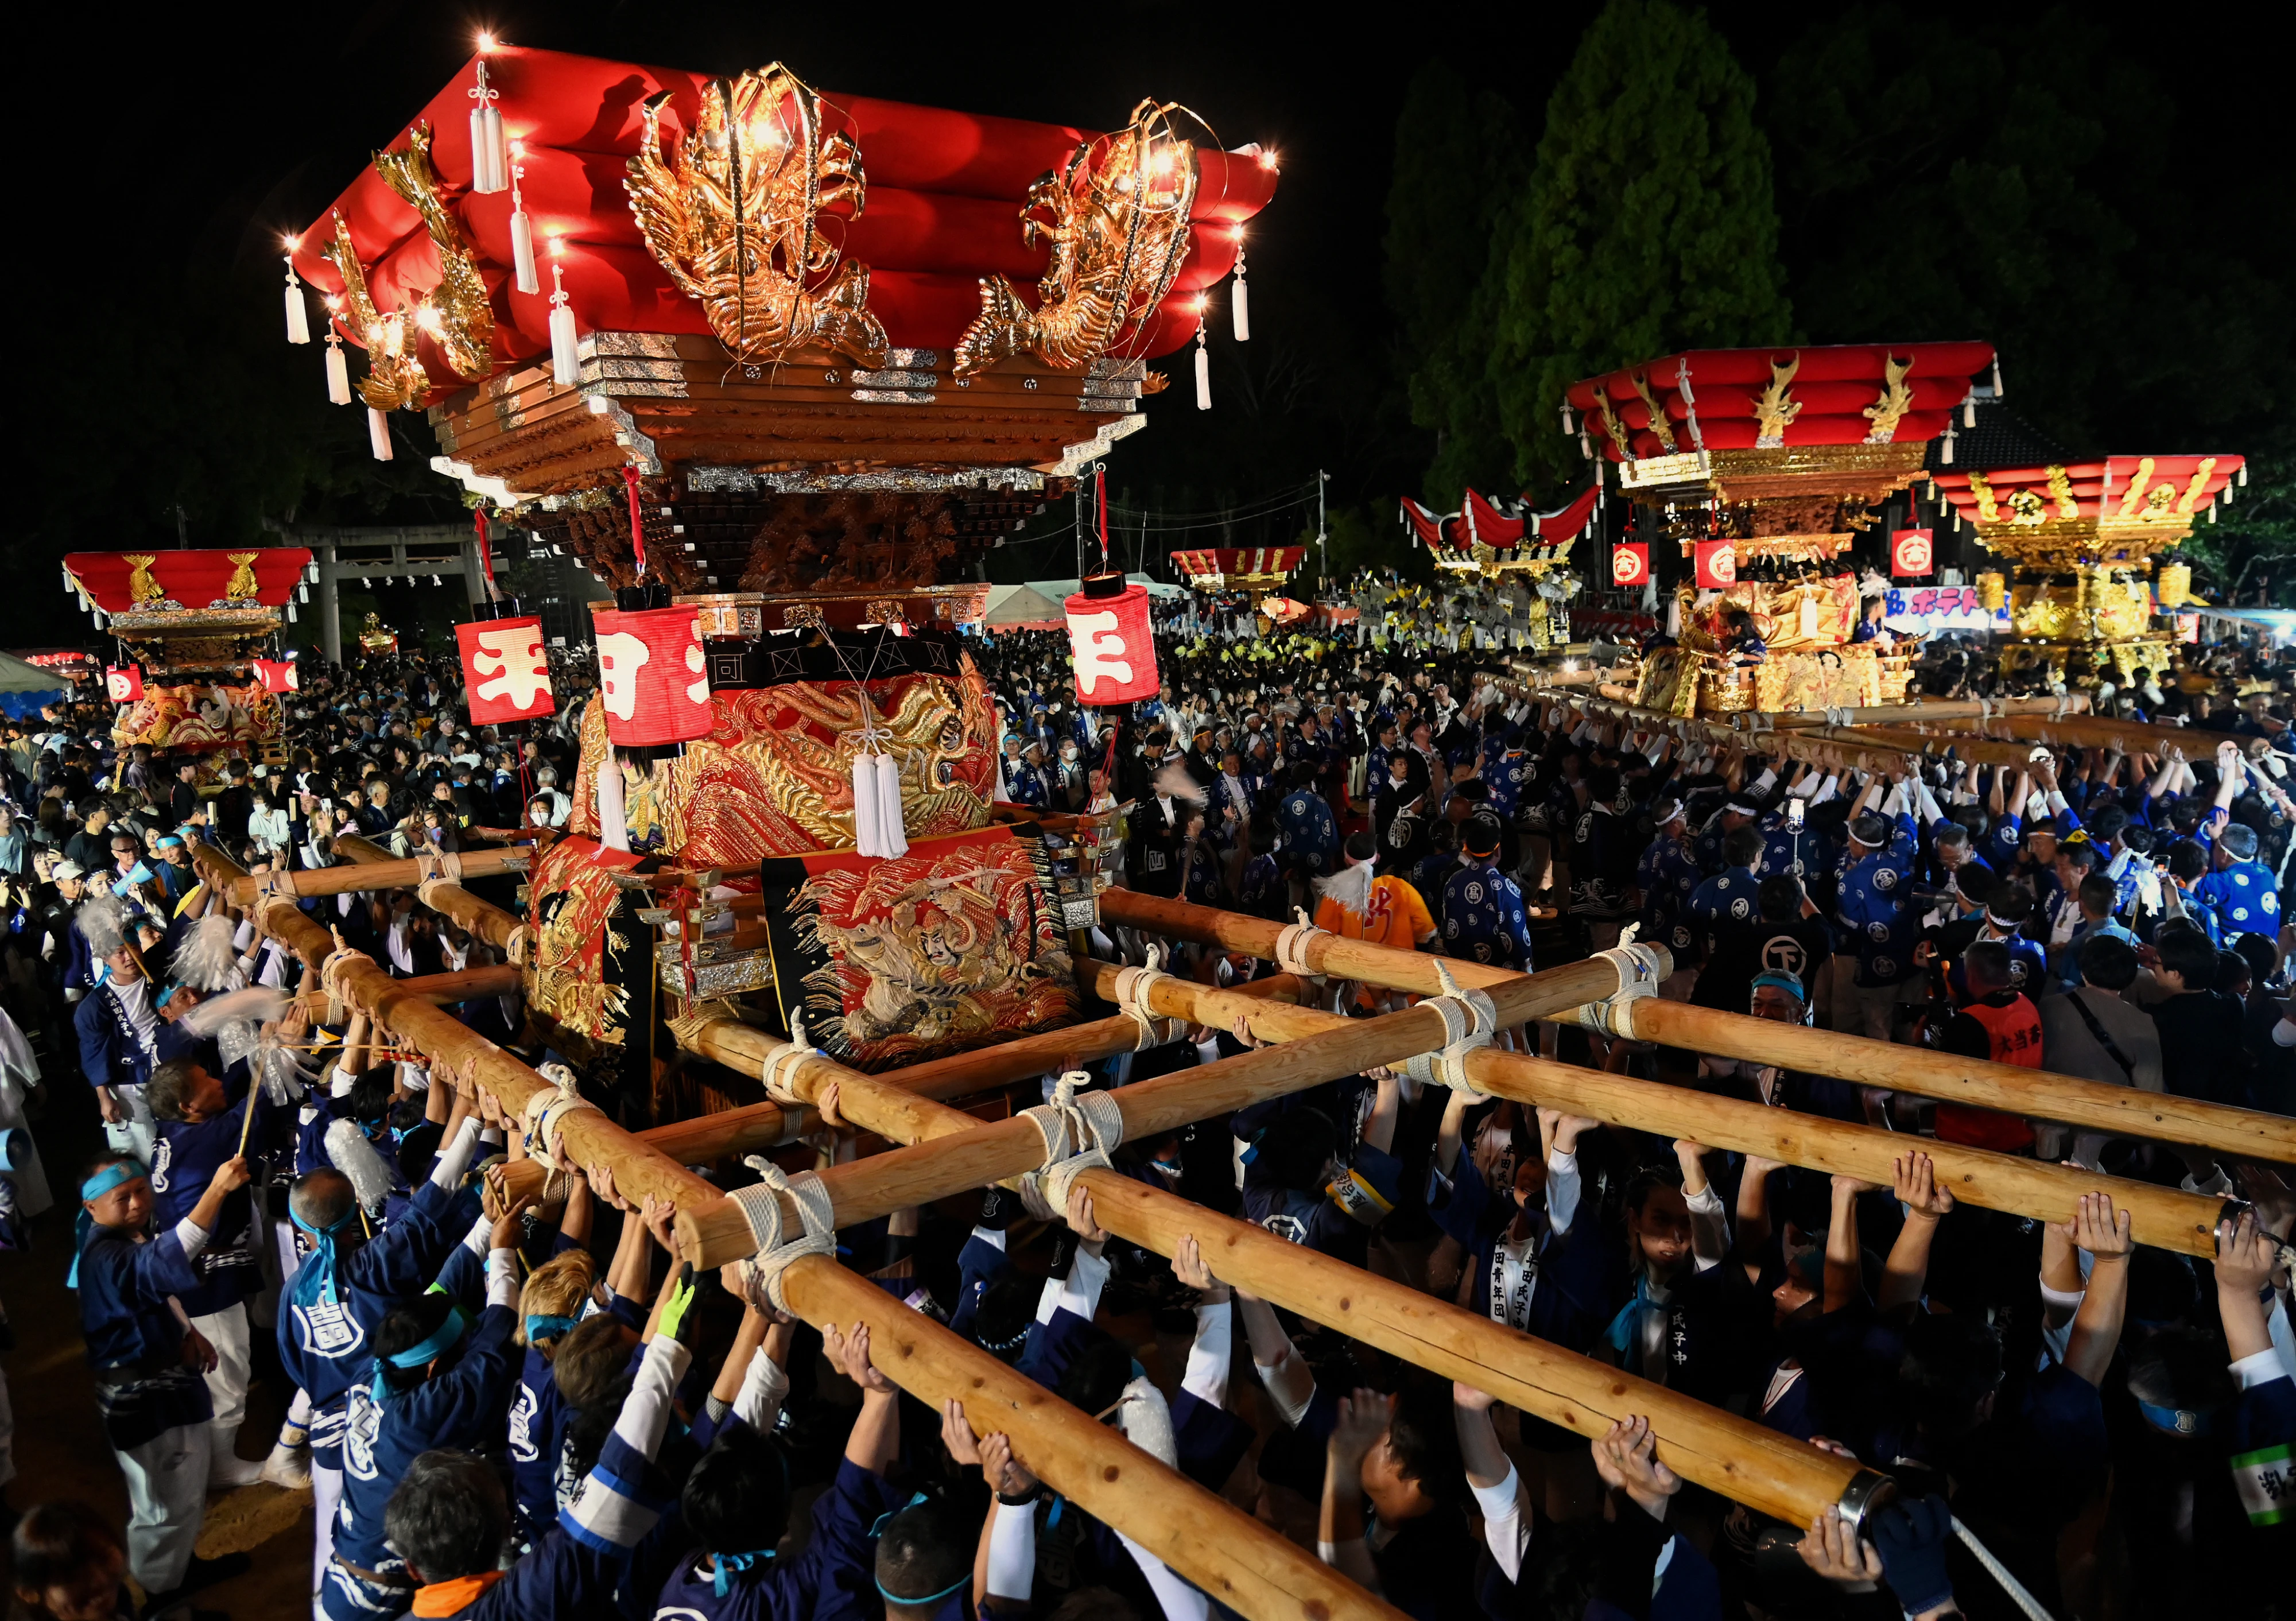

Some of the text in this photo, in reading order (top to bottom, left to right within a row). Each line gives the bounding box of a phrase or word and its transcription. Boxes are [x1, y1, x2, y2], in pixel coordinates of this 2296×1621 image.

[1911, 588, 1979, 616] ポテト
[25, 653, 75, 668] 焼きそば
[1492, 1234, 1508, 1318] 平田青年団
[1512, 1252, 1539, 1330] 平田氏子中
